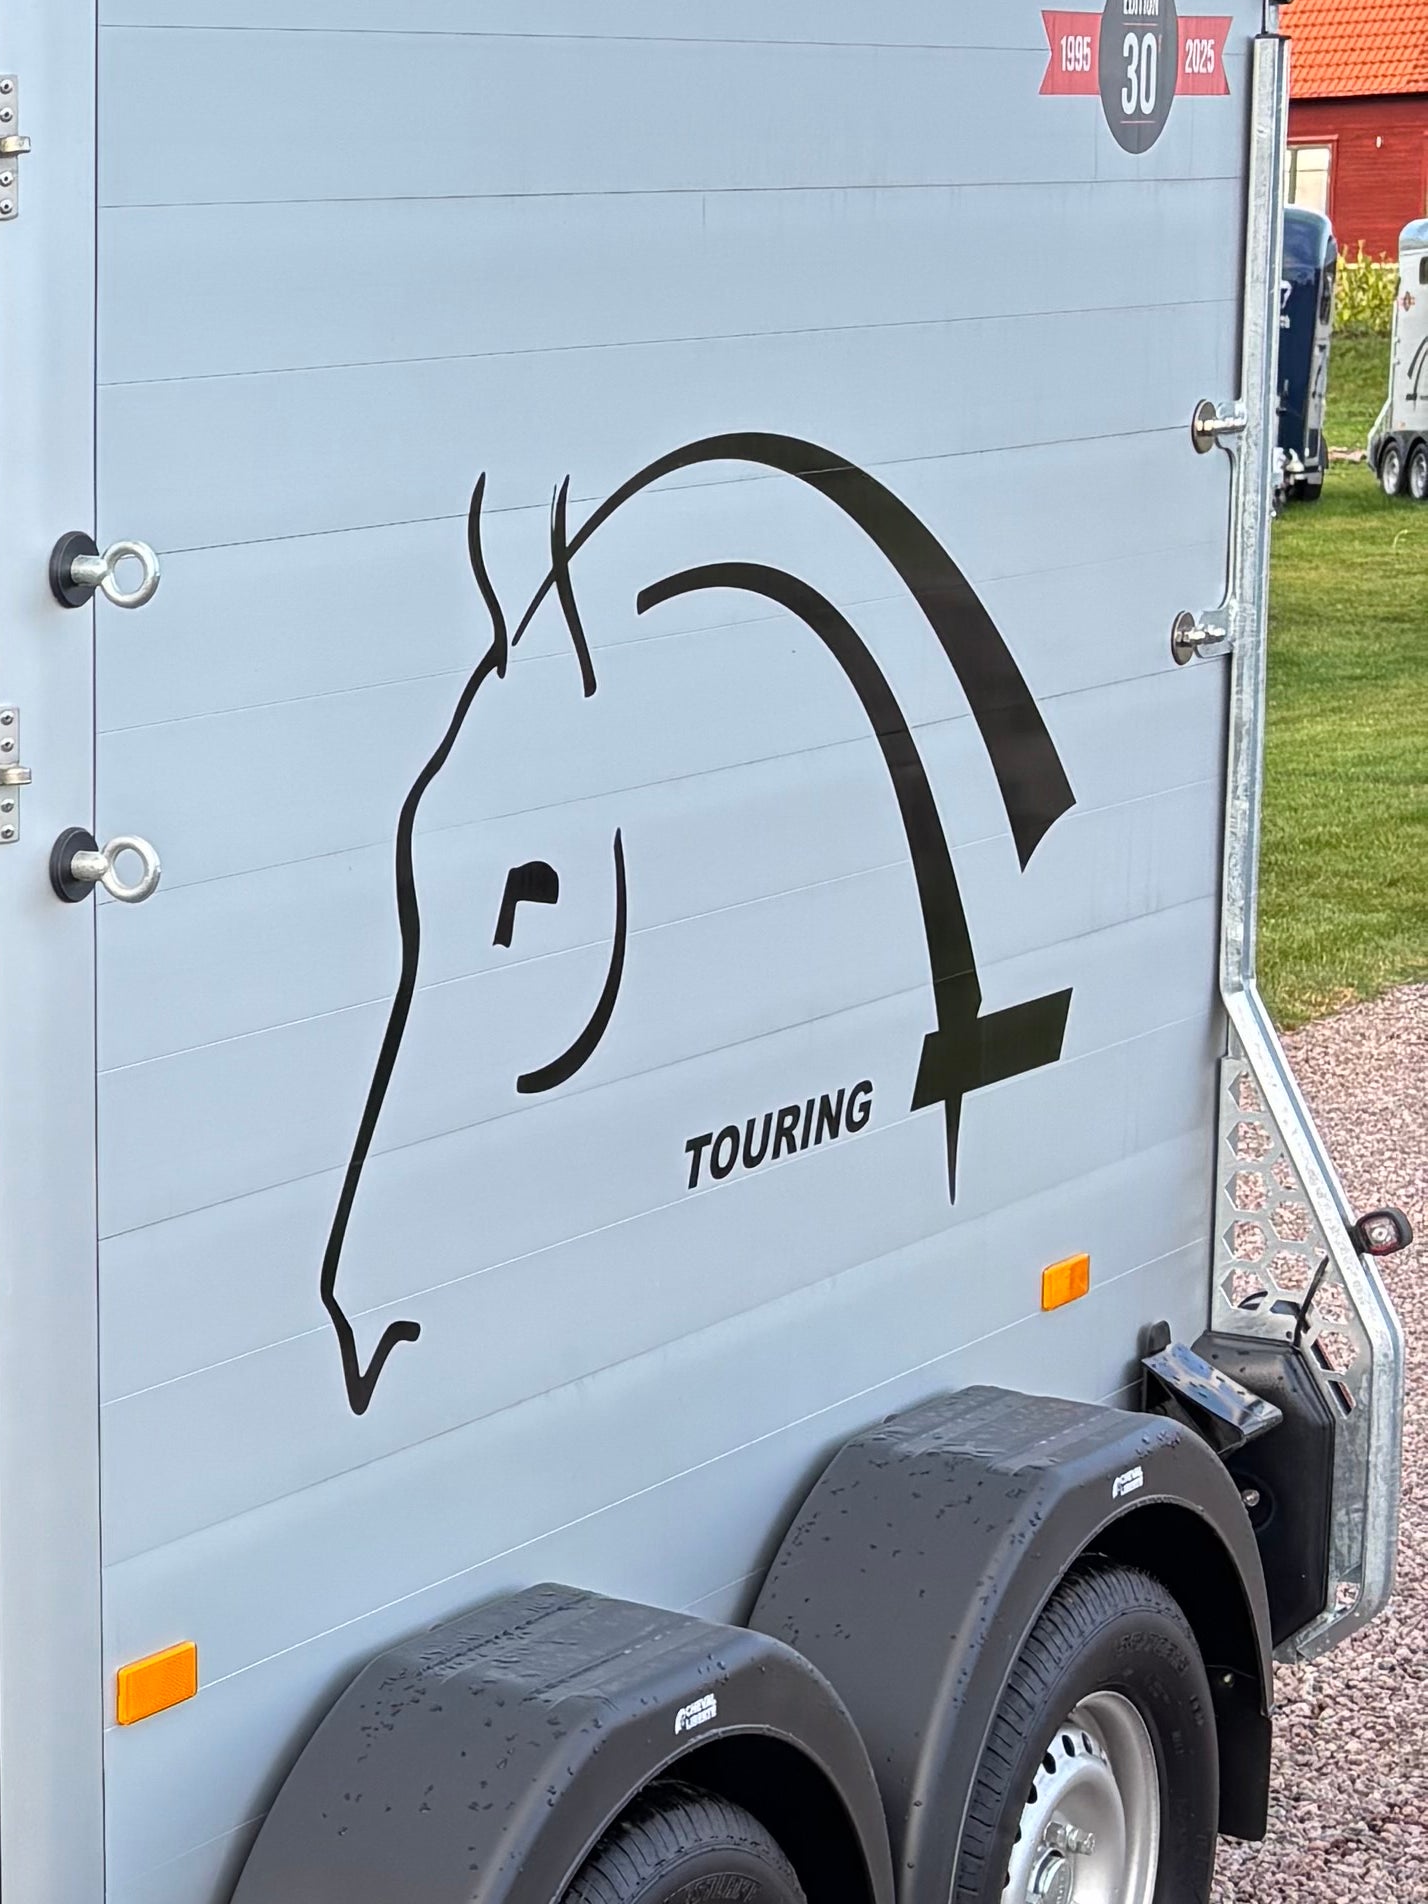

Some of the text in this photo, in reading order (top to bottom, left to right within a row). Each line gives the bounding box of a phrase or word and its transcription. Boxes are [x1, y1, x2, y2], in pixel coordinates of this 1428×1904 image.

[1060, 35, 1092, 72] 1995
[1121, 32, 1158, 115] 30
[1184, 38, 1215, 74] 2025
[684, 1079, 874, 1190] TOURING
